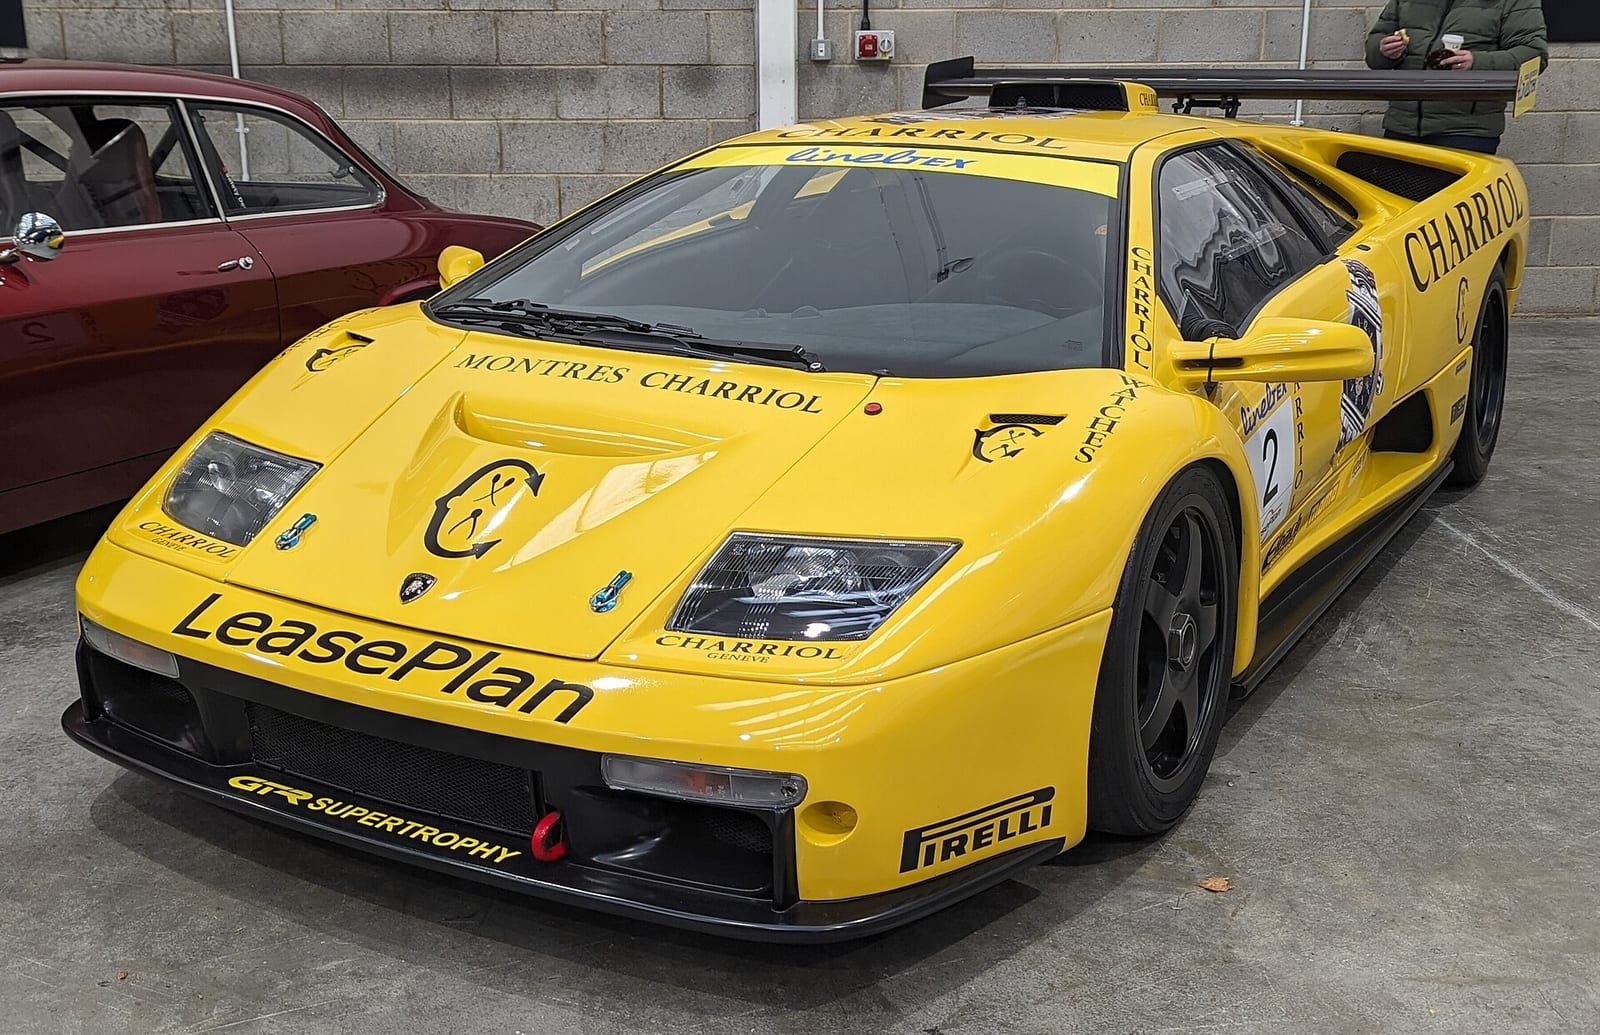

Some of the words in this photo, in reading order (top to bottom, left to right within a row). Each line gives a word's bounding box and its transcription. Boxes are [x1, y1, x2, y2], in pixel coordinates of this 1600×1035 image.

[777, 126, 1067, 150] CHARRIOL
[1404, 172, 1523, 293] CHARRIOL
[1131, 247, 1152, 369] CHARRIOL
[453, 354, 630, 384] MONTRES
[639, 371, 823, 414] CHARRIOL
[1075, 374, 1151, 463] WATCHES
[1263, 428, 1279, 508] 2
[139, 521, 238, 558] CHARRIOL
[171, 593, 595, 725] LeasePlan
[656, 635, 842, 660] CHARRIOL
[707, 652, 770, 664] GENEVE
[228, 775, 313, 806] GTR
[307, 797, 522, 864] SUPERTROPHY
[899, 786, 1055, 874] PIRELLI
